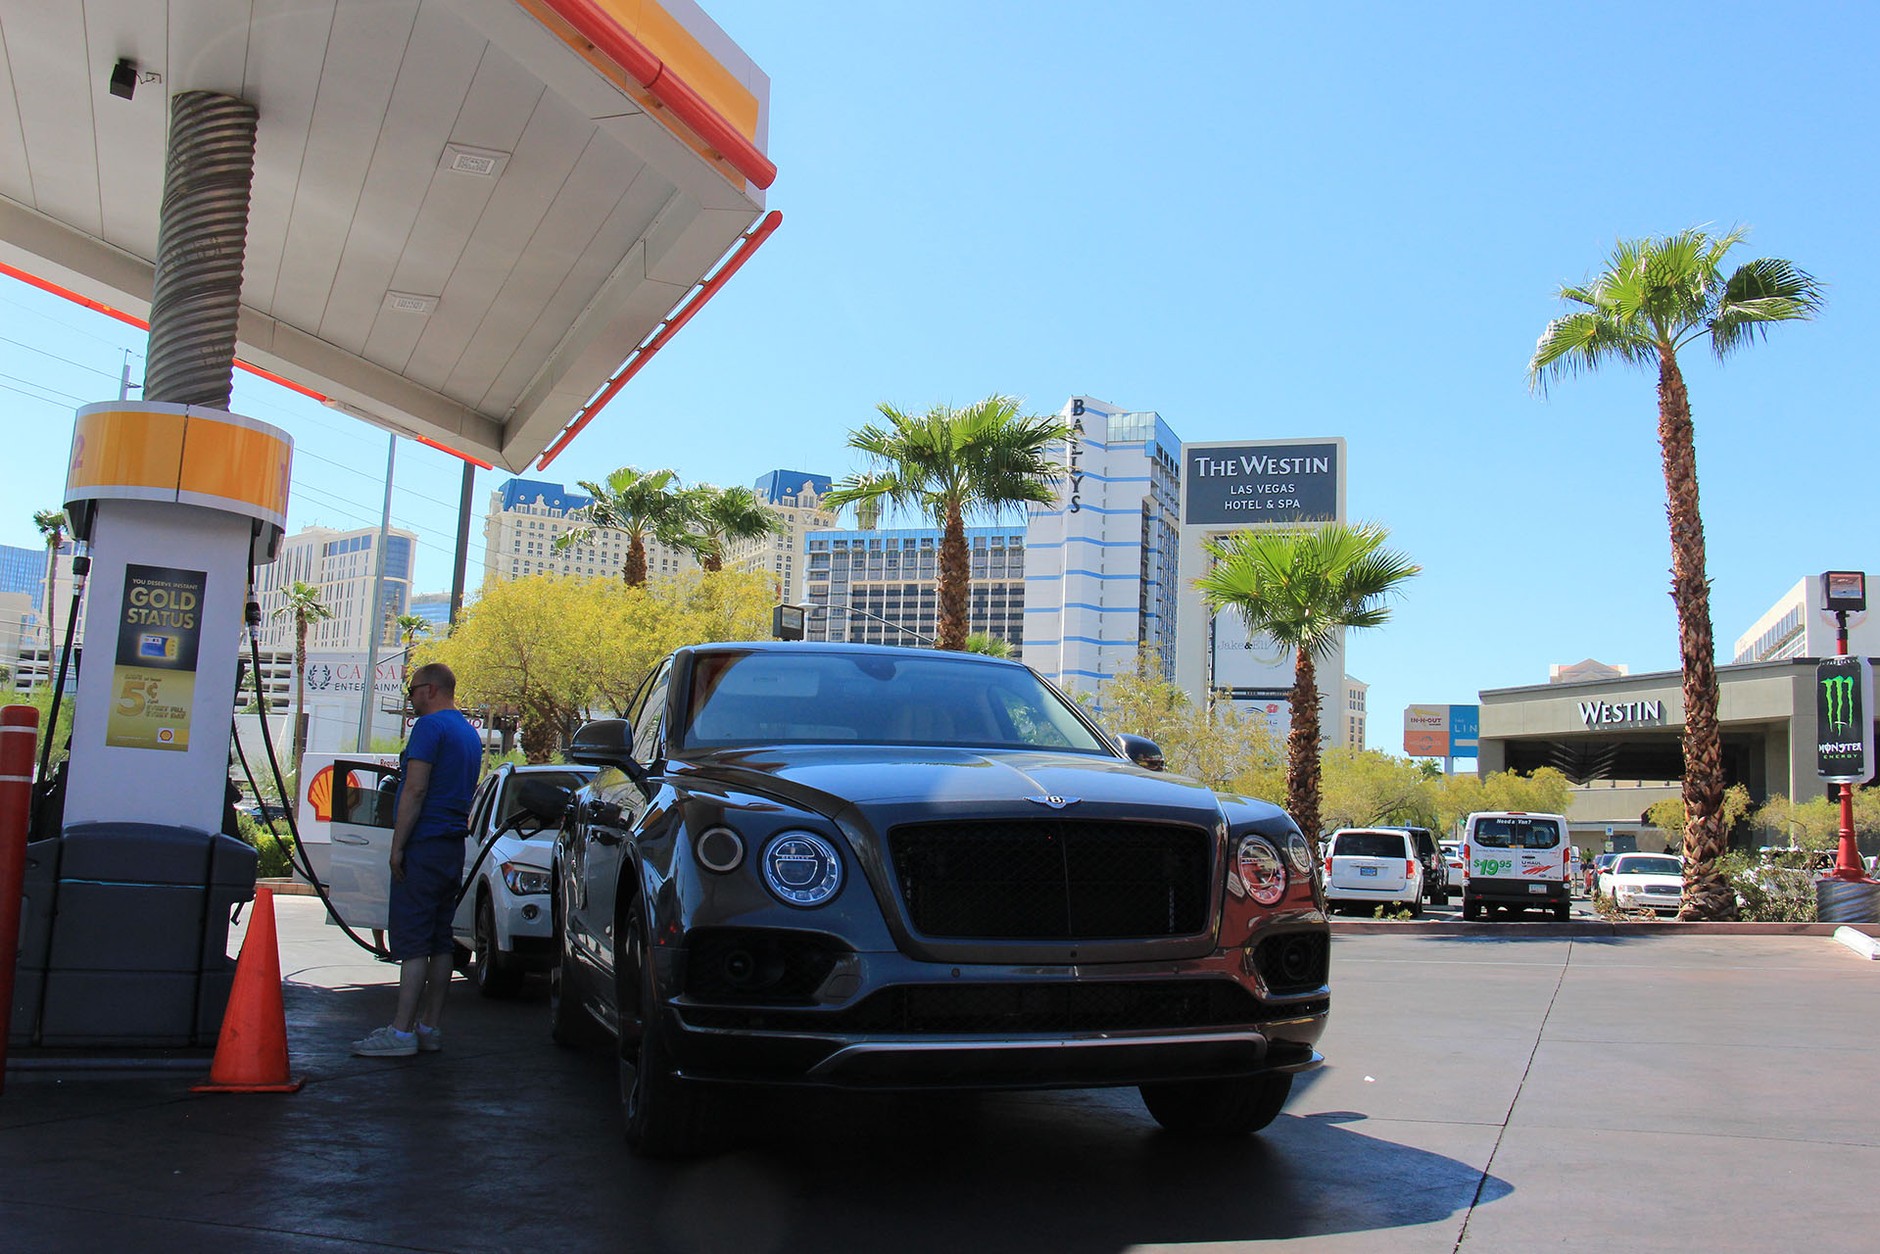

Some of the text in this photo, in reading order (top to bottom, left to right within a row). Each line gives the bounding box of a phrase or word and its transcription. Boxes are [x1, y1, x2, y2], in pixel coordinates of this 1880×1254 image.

[1194, 455, 1329, 477] THE WESTIN
[1230, 483, 1295, 495] LAS VEGAS
[1224, 499, 1301, 510] HOTEL & SPA
[147, 579, 172, 587] DESERVE
[129, 586, 197, 611] GOLD
[127, 607, 195, 629] STATUS
[336, 663, 408, 680] CASA
[334, 682, 404, 692] ENTERAINM
[1577, 699, 1661, 724] WESTIN
[1454, 724, 1478, 733] LIN
[1818, 742, 1862, 754] MONSTER
[379, 758, 400, 768] Regula
